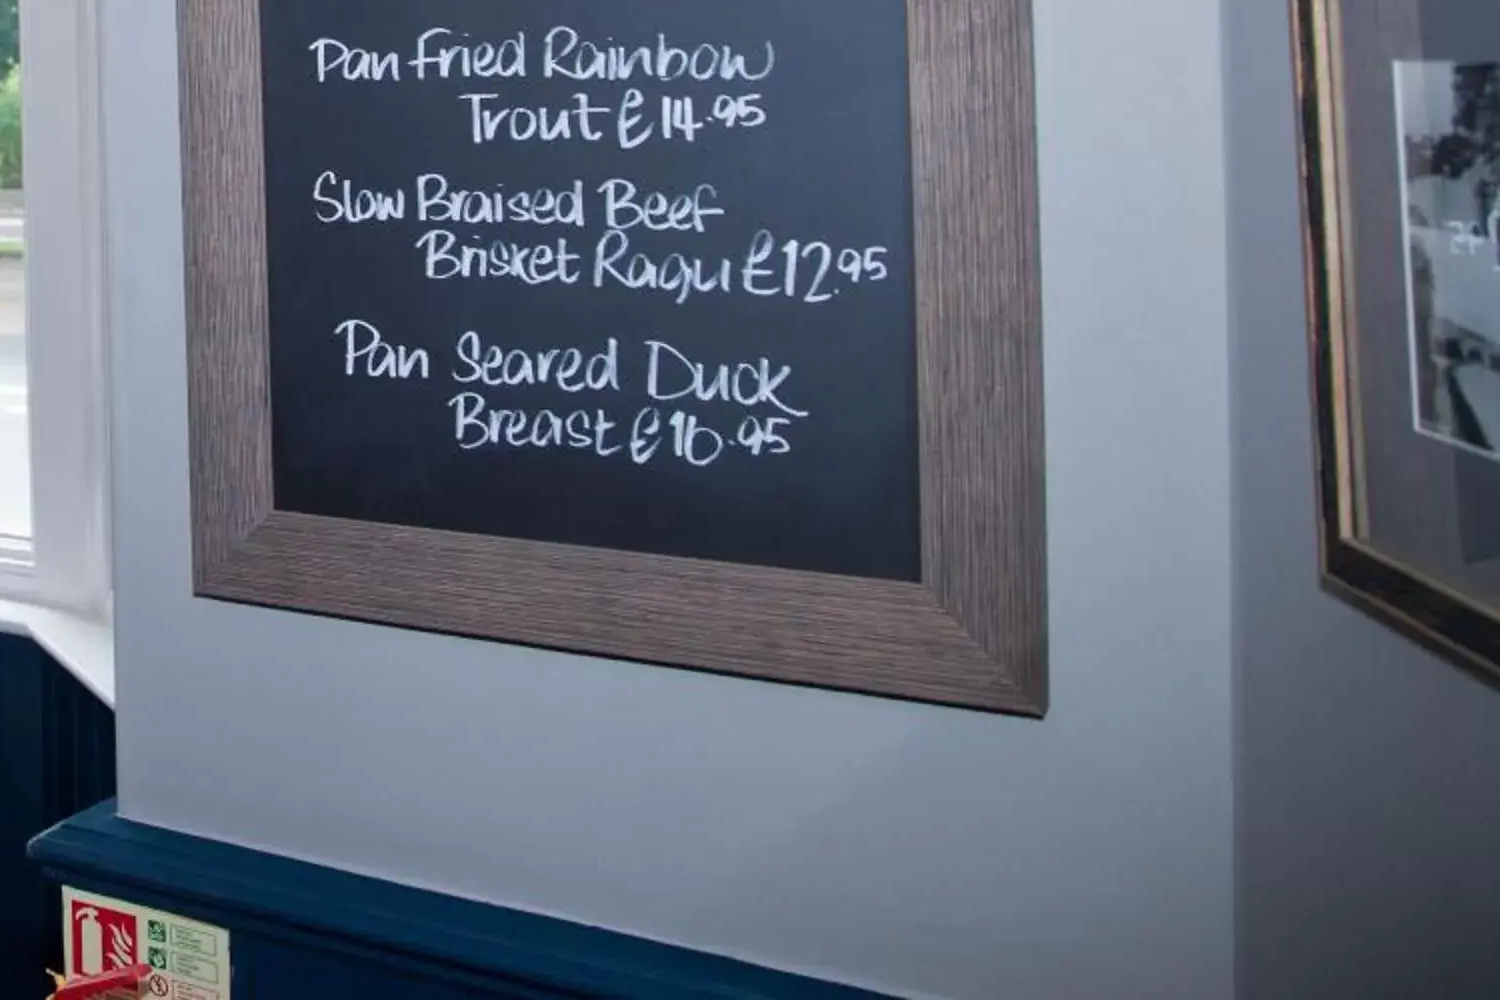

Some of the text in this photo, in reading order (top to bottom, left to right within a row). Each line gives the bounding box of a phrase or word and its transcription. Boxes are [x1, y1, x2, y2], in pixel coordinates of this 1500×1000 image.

[308, 36, 401, 83] Pan
[544, 25, 775, 81] Rainbow
[458, 88, 767, 149] Trout £14.95
[312, 170, 725, 232] Slow Braised Beef
[415, 228, 888, 304] Brisket Ragu £12.95
[333, 318, 809, 417] Pan Seared Duck
[447, 390, 623, 456] Breast
